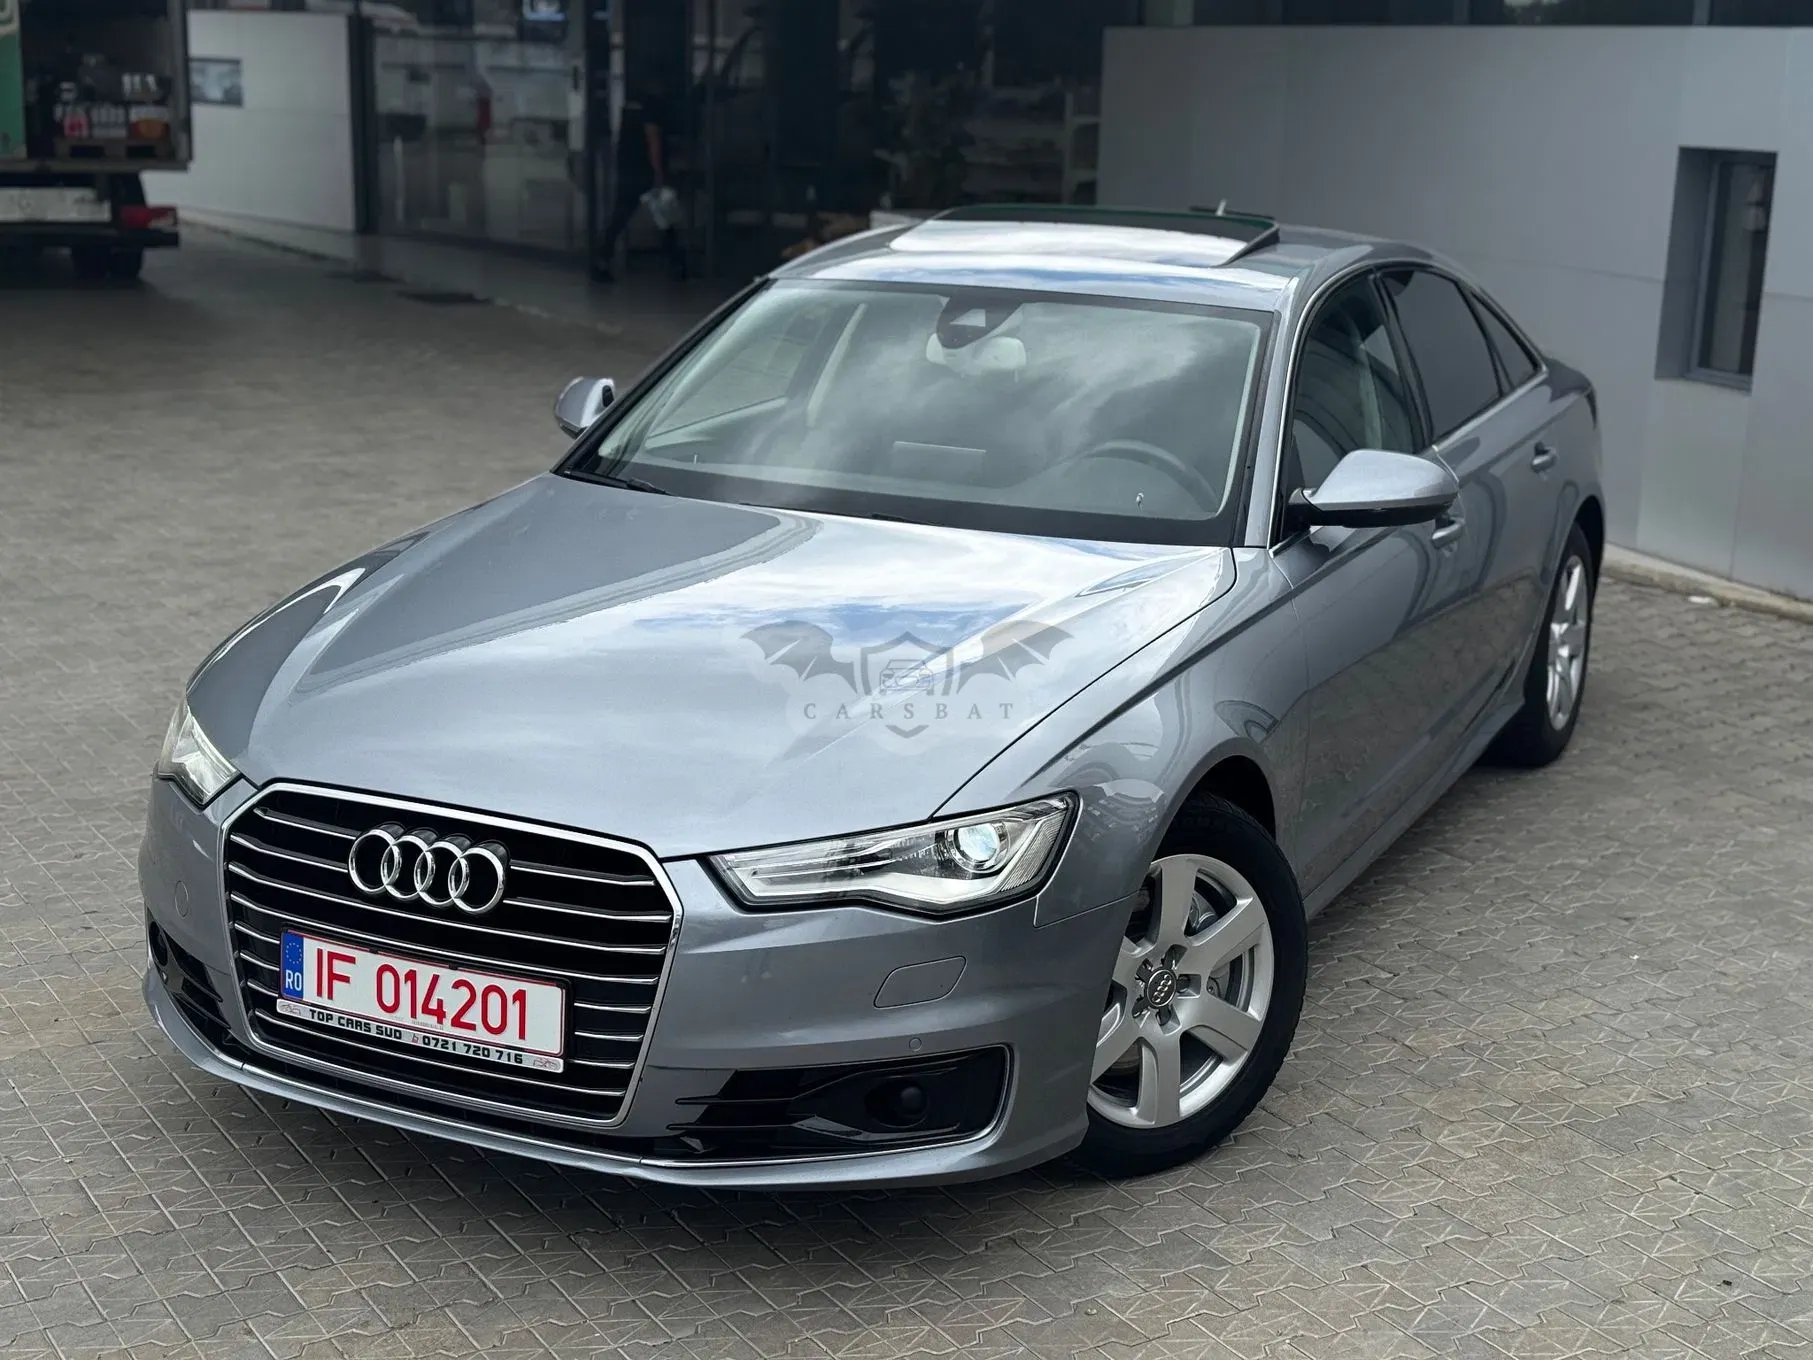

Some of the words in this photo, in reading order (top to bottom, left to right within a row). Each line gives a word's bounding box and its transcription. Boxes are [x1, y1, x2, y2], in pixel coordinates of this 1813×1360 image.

[285, 969, 302, 991] RO
[316, 947, 357, 1001] IF
[376, 963, 527, 1041] 014201
[309, 1008, 334, 1024] TOP
[337, 1016, 372, 1034] CARS
[375, 1025, 403, 1040] SUD
[422, 1035, 457, 1052] 0721
[463, 1043, 491, 1058] 720
[495, 1049, 524, 1064] 716
